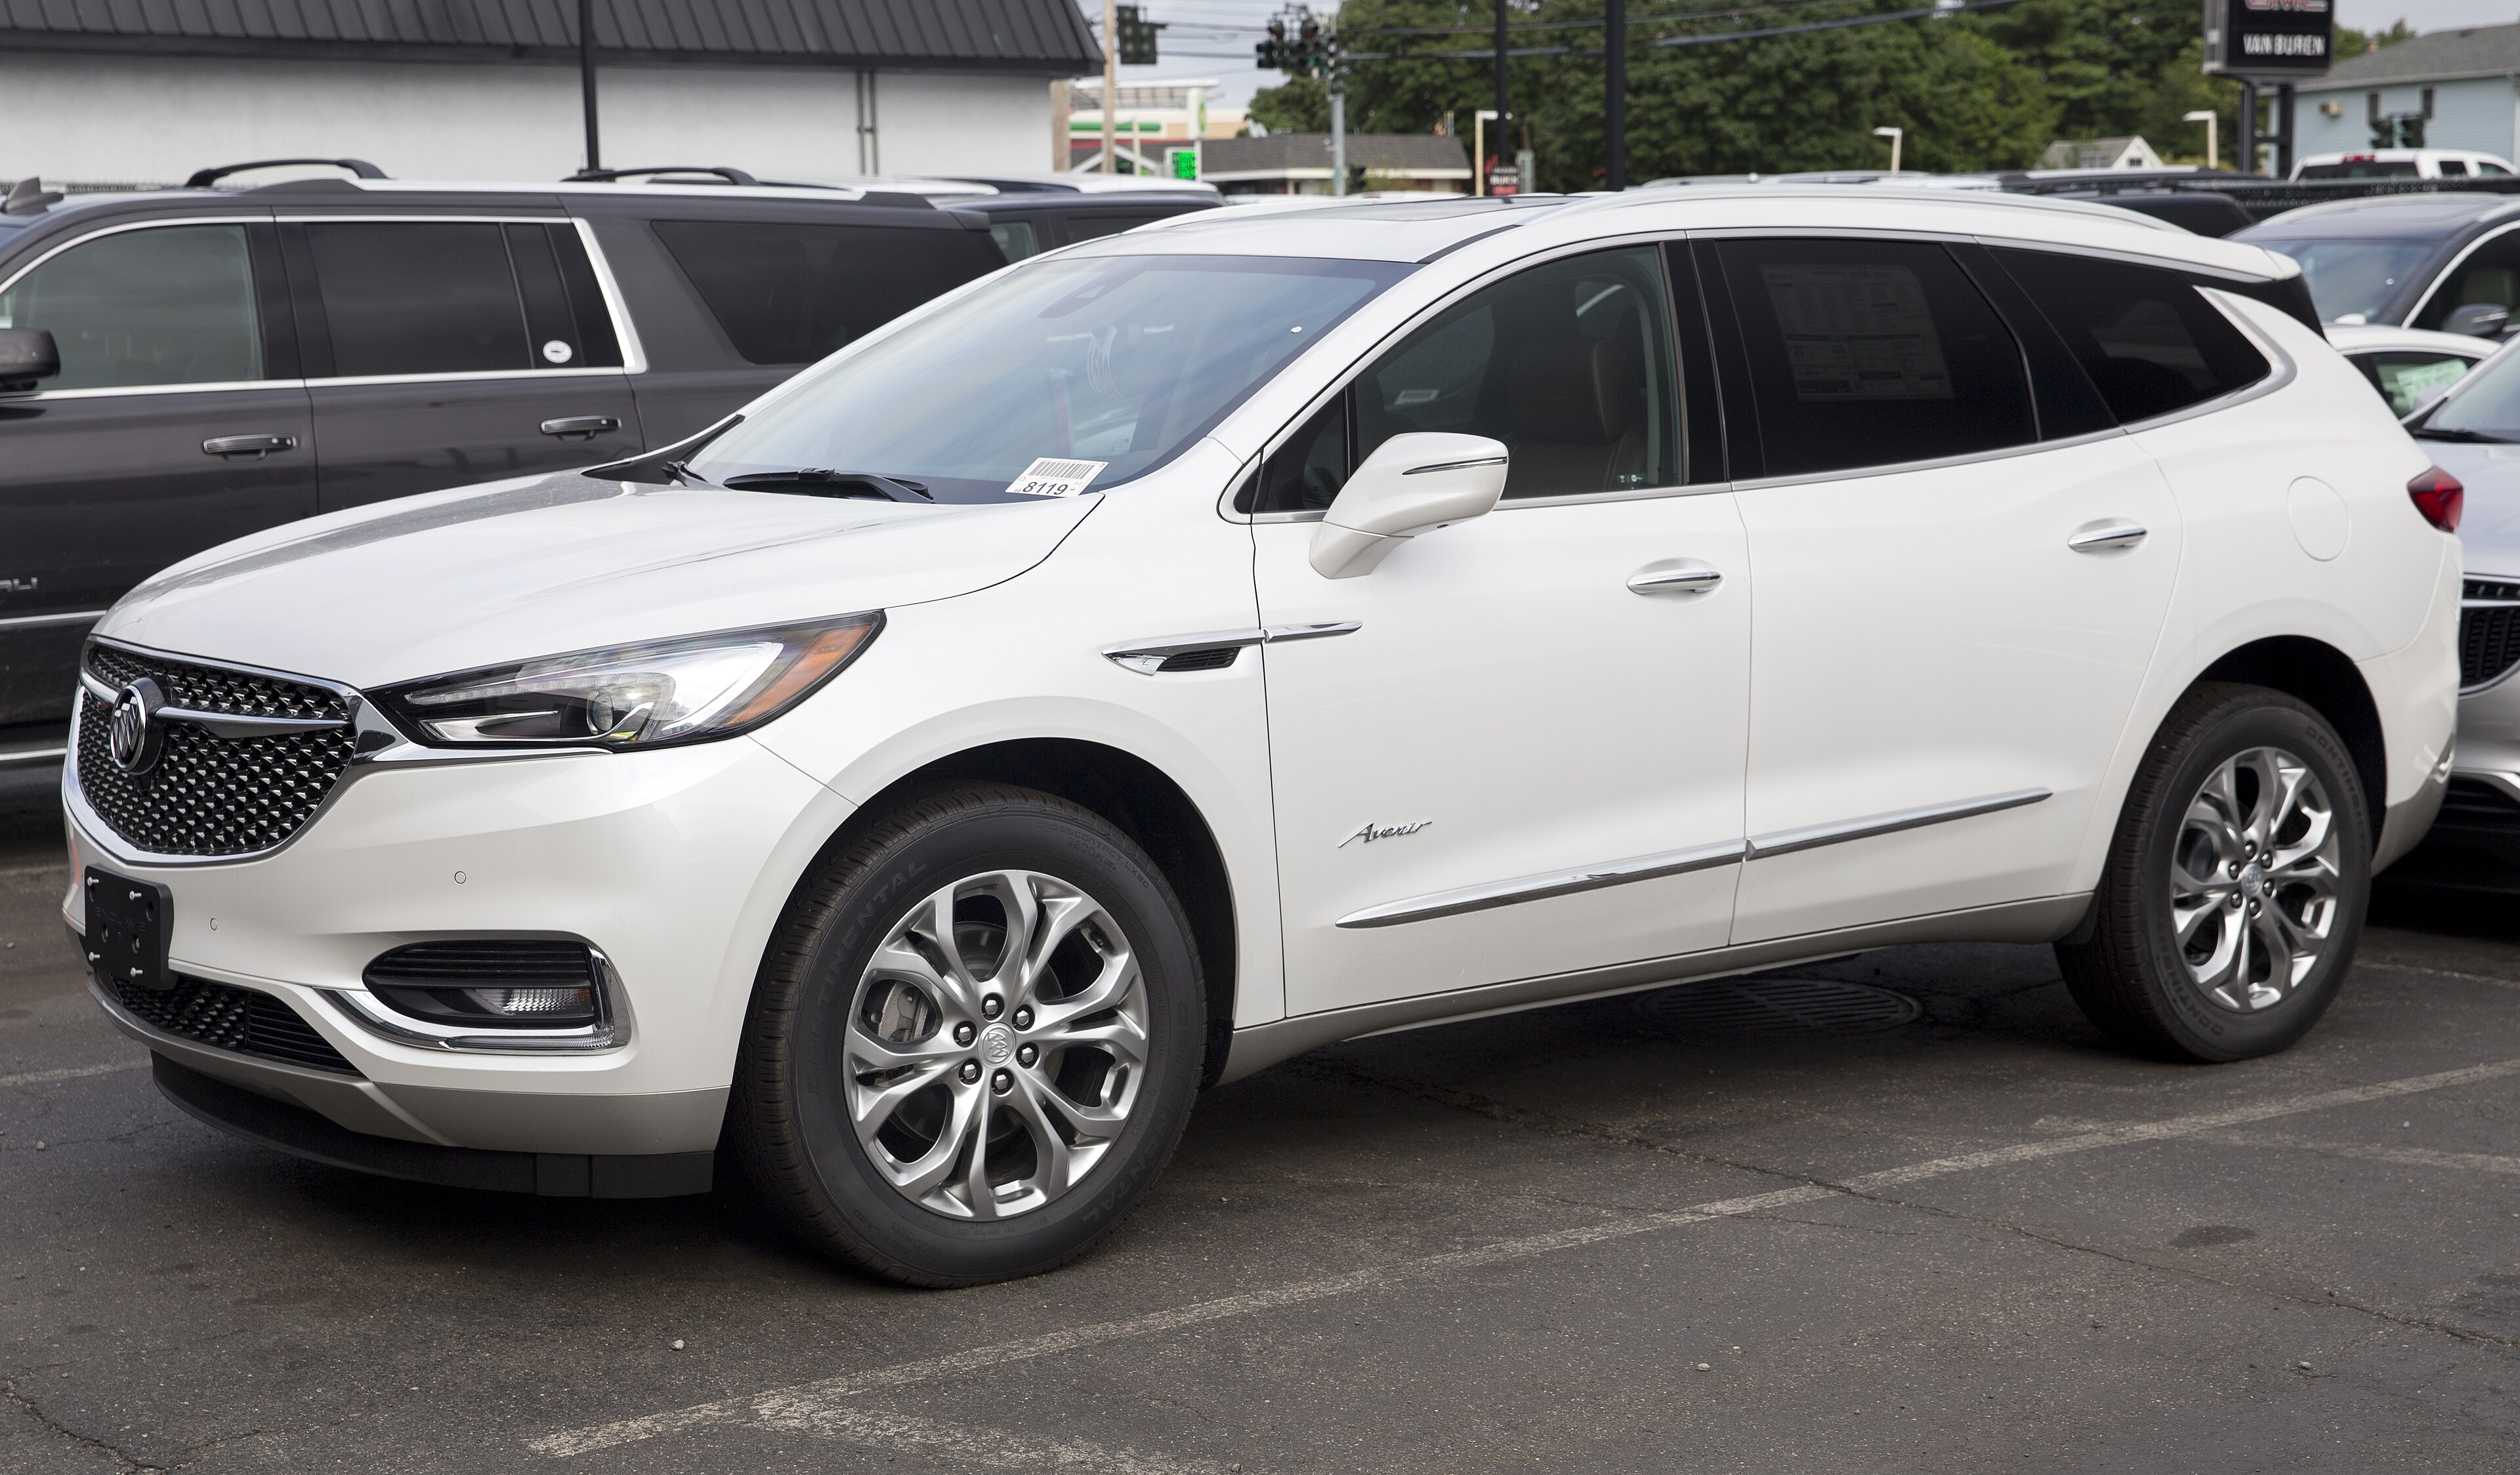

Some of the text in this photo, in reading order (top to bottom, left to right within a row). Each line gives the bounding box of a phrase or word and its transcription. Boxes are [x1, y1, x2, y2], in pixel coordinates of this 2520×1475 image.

[2244, 33, 2326, 56] VAN BUREN
[1022, 481, 1068, 495] 8119
[1337, 820, 1433, 848] Avenir
